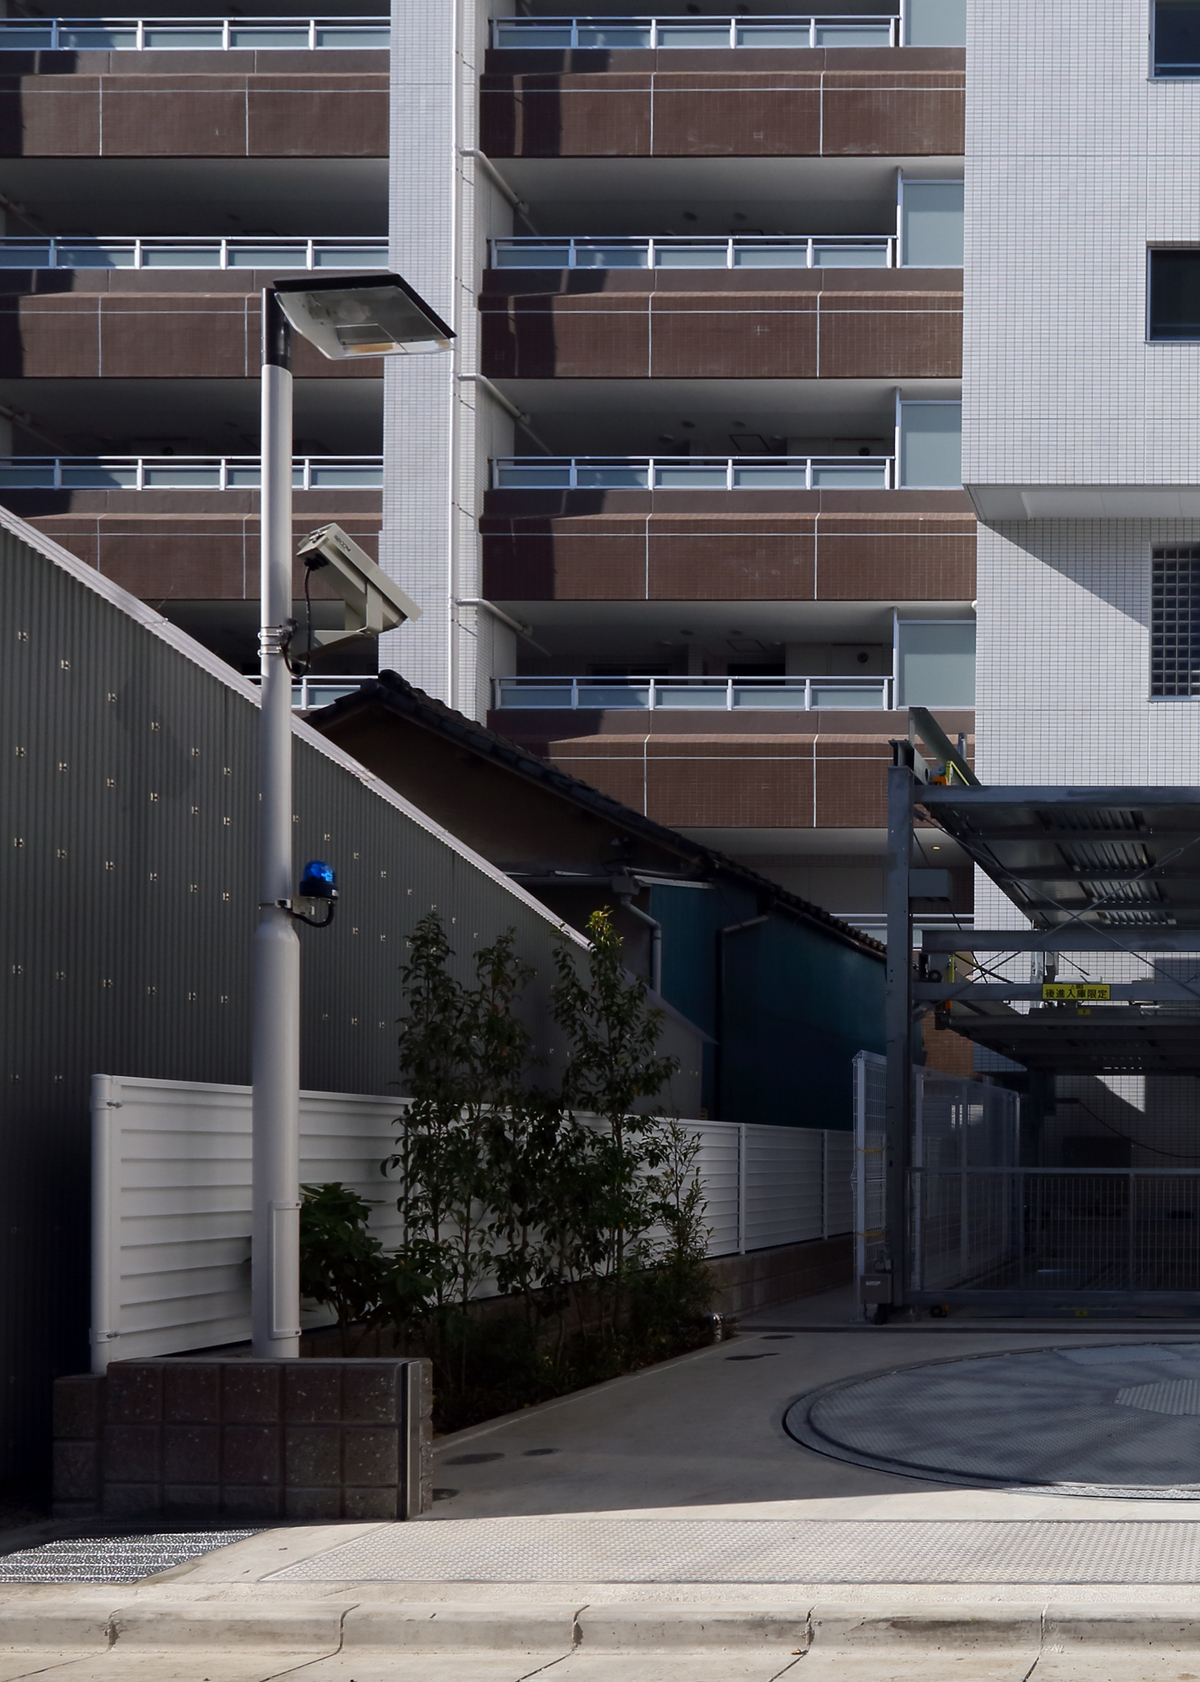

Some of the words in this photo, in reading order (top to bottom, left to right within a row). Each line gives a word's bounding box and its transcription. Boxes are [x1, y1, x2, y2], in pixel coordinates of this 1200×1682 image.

[1045, 988, 1108, 999] 後進入庫限定
